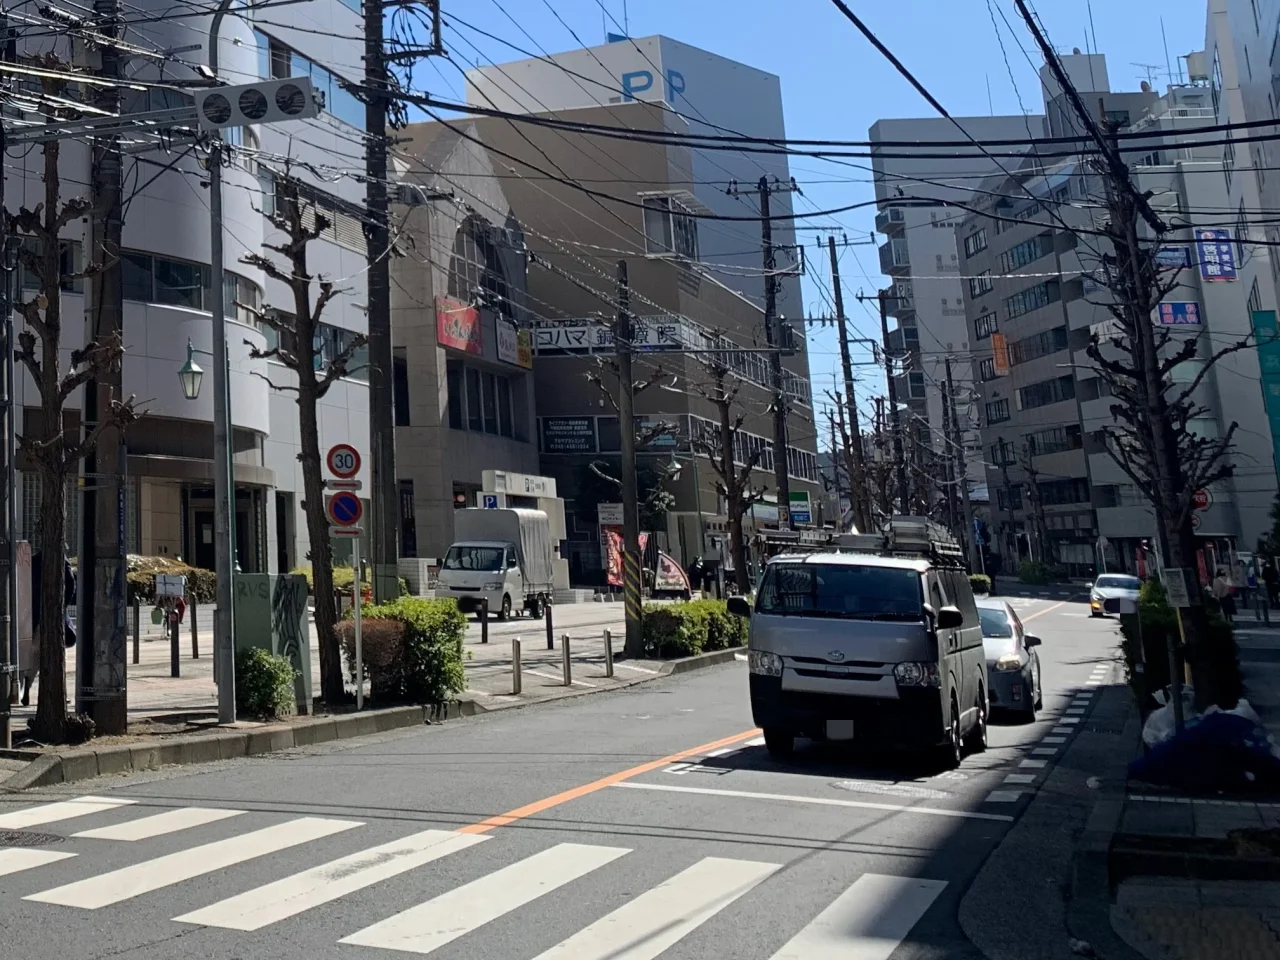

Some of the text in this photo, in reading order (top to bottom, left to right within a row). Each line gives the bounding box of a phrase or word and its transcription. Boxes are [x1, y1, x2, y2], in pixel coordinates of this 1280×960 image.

[622, 70, 653, 102] P
[667, 69, 686, 102] P
[335, 453, 354, 469] 30
[485, 496, 494, 508] P
